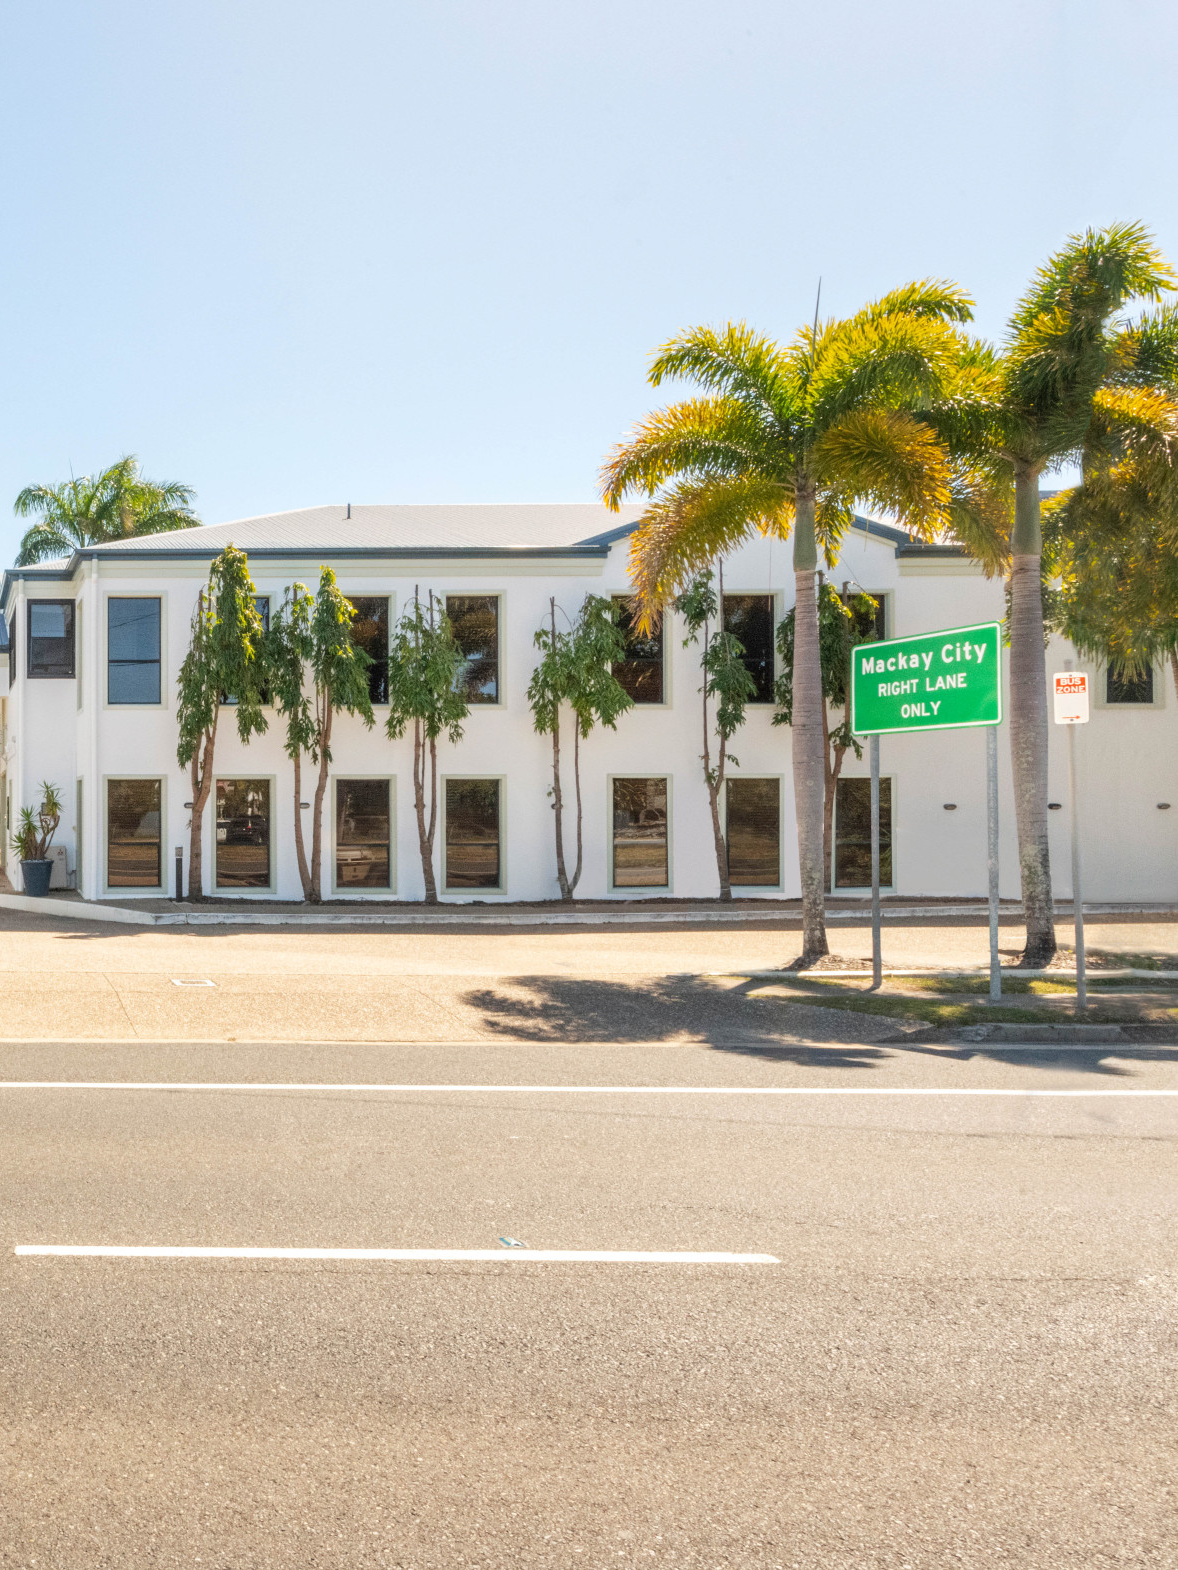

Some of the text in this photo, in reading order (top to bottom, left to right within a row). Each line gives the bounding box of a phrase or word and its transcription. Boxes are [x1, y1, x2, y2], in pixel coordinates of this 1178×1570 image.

[861, 641, 987, 676] Mackay City
[878, 673, 967, 697] RIGHT LANE
[1056, 685, 1086, 694] ZONE
[1060, 677, 1082, 686] BUS
[900, 701, 941, 719] ONLY
